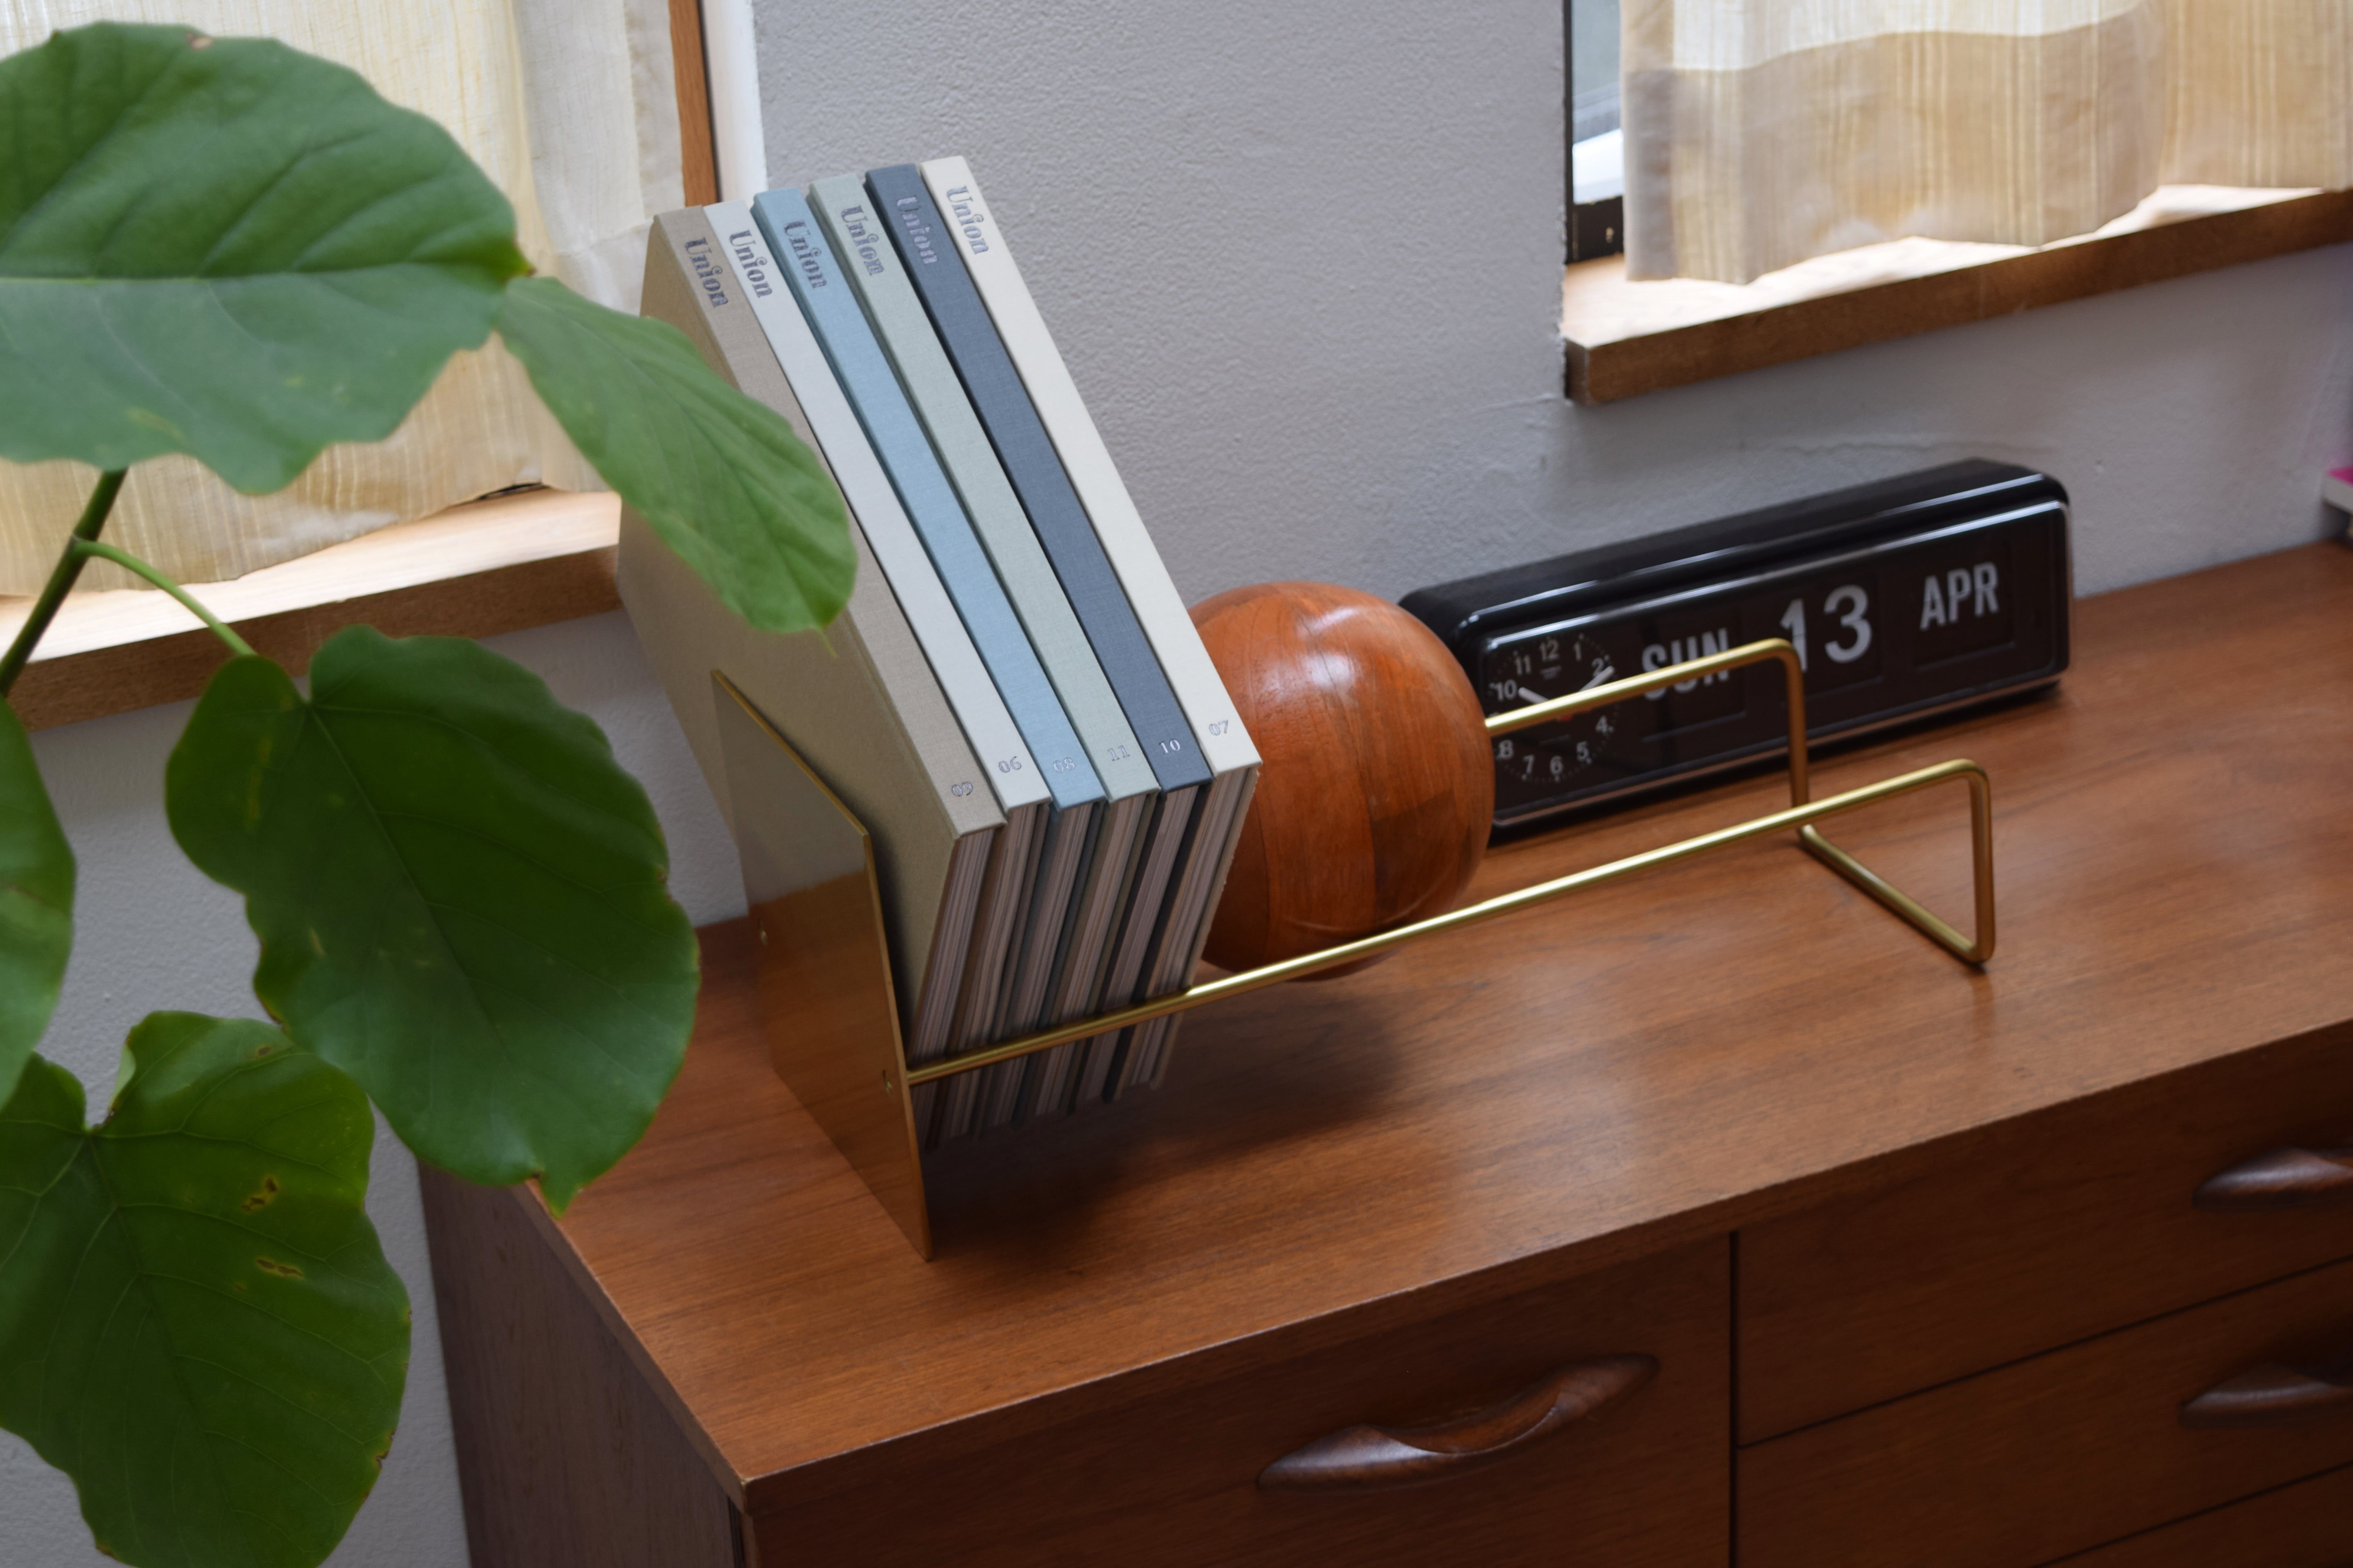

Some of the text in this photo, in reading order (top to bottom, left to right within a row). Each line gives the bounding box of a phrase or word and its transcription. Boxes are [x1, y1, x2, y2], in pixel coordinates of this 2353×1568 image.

[897, 195, 938, 265] Union
[947, 186, 989, 254] Union
[841, 205, 884, 275] Union
[729, 230, 772, 297] Union
[784, 220, 827, 288] Union
[684, 237, 728, 307] Union
[1641, 562, 1998, 700] SUN 13 APR
[1539, 639, 1559, 661] 12
[1573, 642, 1582, 661] 1
[1514, 655, 1531, 675] 11
[1592, 658, 1606, 676] 2
[1495, 679, 1517, 701] 10
[1209, 720, 1228, 736] 07
[1596, 715, 1608, 734] 4
[1107, 745, 1130, 761] 11
[1159, 739, 1181, 754] 10
[1498, 740, 1514, 760] 8
[1576, 741, 1589, 761] 5
[998, 756, 1022, 773] 06
[1053, 758, 1076, 773] 08
[1523, 754, 1534, 773] 7
[1550, 756, 1563, 774] 6
[951, 782, 973, 797] 09
